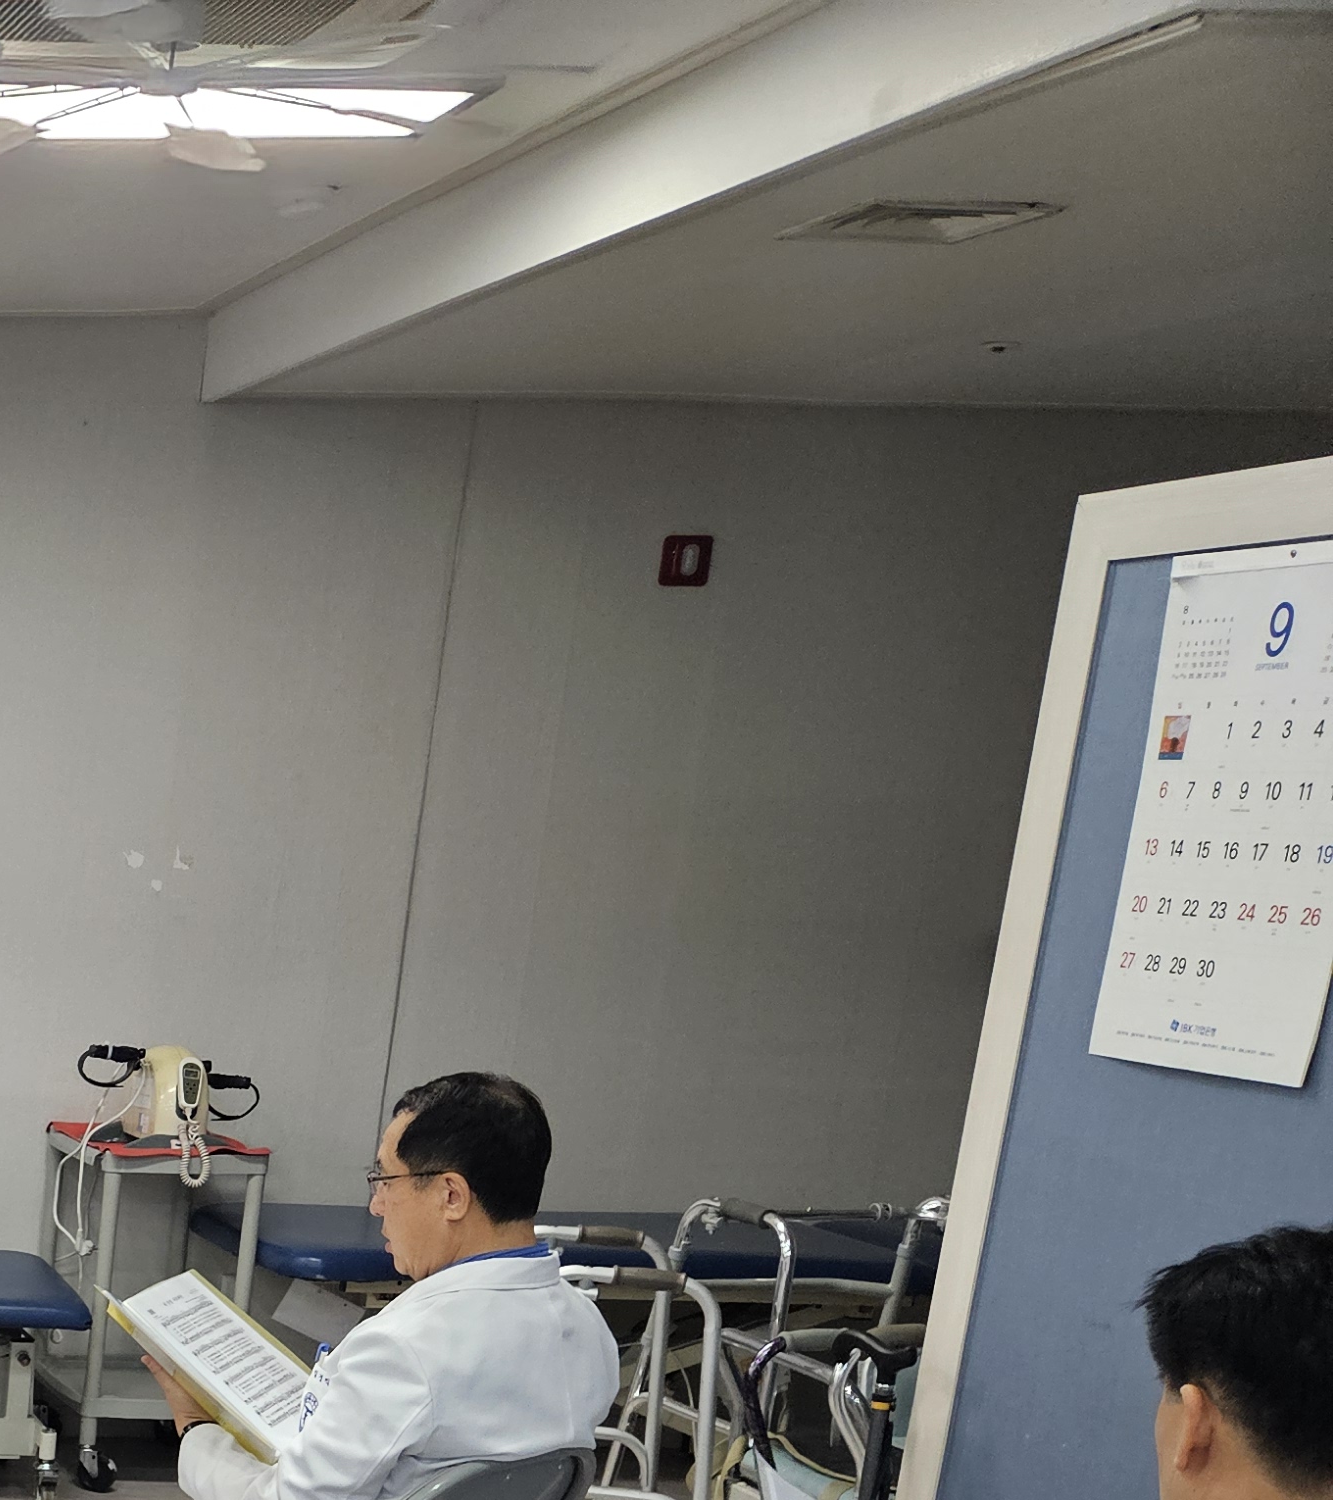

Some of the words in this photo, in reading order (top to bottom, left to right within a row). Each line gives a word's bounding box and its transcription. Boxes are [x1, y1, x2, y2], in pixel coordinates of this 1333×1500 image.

[1265, 601, 1295, 658] 9
[1255, 662, 1289, 671] SEPTEMBER
[1227, 722, 1233, 740] 1
[1251, 720, 1262, 739] 2
[1282, 720, 1293, 738] 3
[1313, 719, 1325, 738] 4
[1159, 781, 1169, 798] 6
[1186, 781, 1196, 799] 7
[1211, 781, 1222, 800] 8
[1239, 781, 1250, 800] 9
[1265, 781, 1282, 801] 10
[1298, 782, 1313, 801] 11
[1145, 838, 1159, 856] 13
[1170, 840, 1184, 857] 14
[1197, 841, 1211, 858] 15
[1223, 842, 1239, 860] 16
[1252, 843, 1269, 861] 17
[1283, 844, 1301, 863] 18
[1317, 845, 1333, 864] 19
[1131, 895, 1148, 913] 20
[1157, 897, 1172, 915] 21
[1181, 899, 1200, 917] 22
[1209, 900, 1228, 919] 23
[1237, 902, 1256, 922] 24
[1267, 905, 1288, 924] 25
[1300, 907, 1322, 926] 26
[1119, 952, 1136, 969] 27
[1144, 954, 1161, 972] 28
[1169, 956, 1187, 975] 29
[1196, 959, 1215, 978] 30
